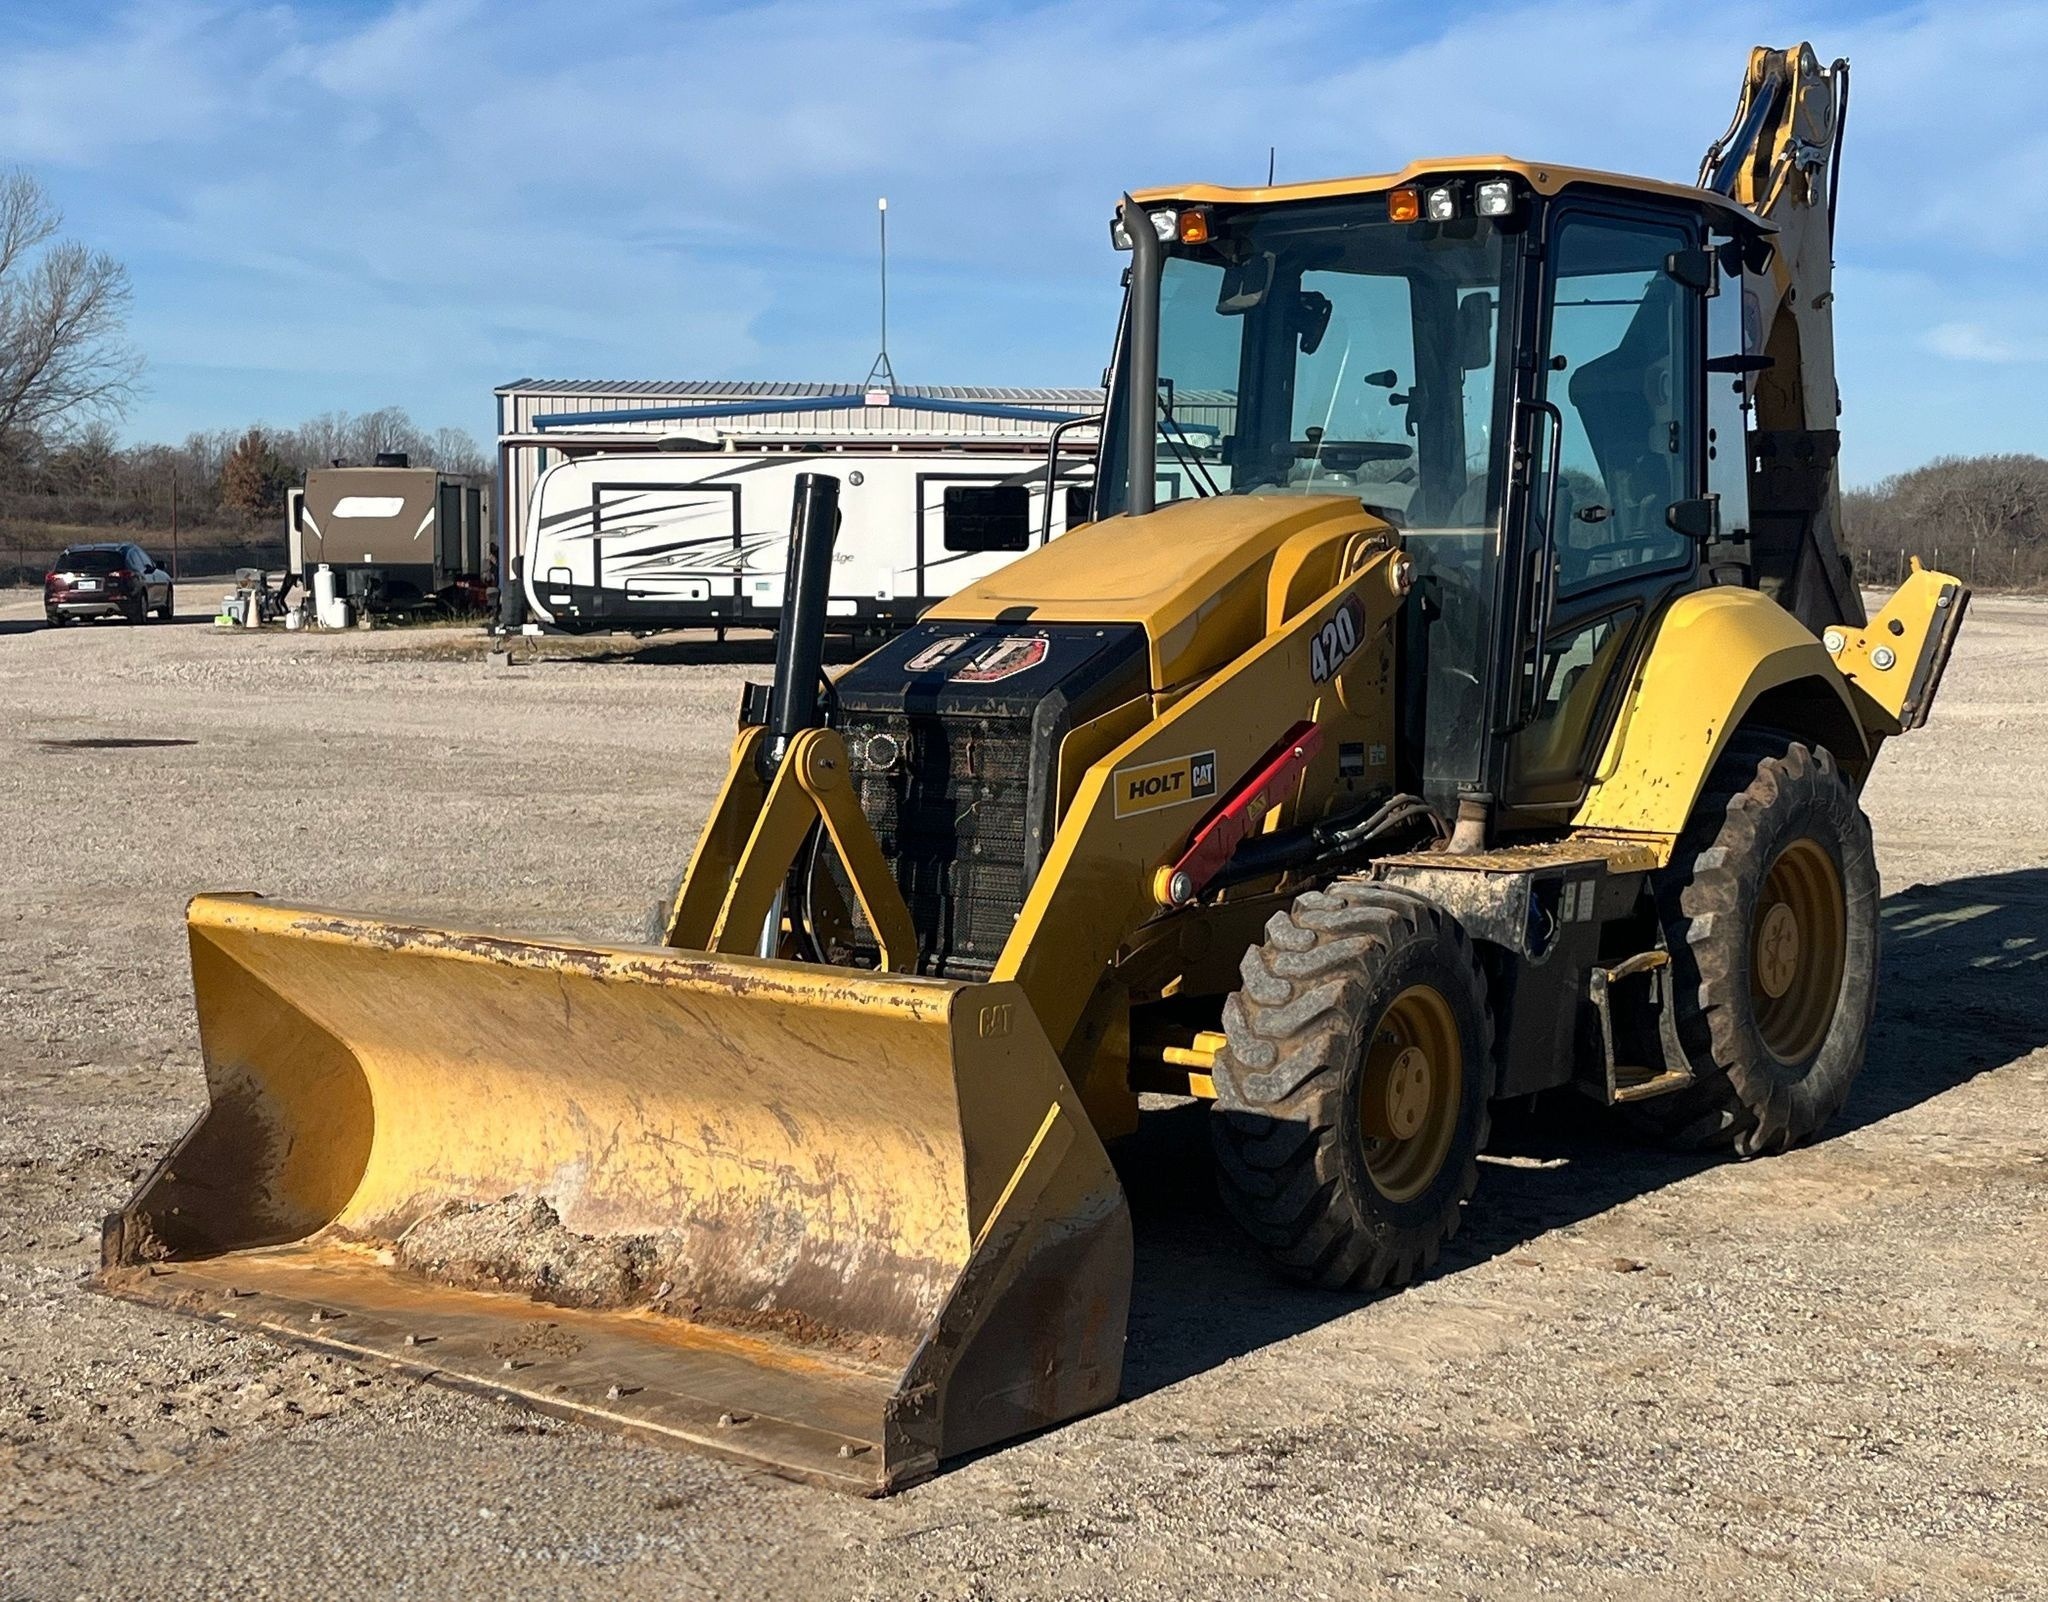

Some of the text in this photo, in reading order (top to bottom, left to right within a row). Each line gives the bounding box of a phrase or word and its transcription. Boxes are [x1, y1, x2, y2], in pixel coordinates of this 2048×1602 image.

[1312, 607, 1356, 682] 420
[1129, 763, 1212, 799] HOLT CAT
